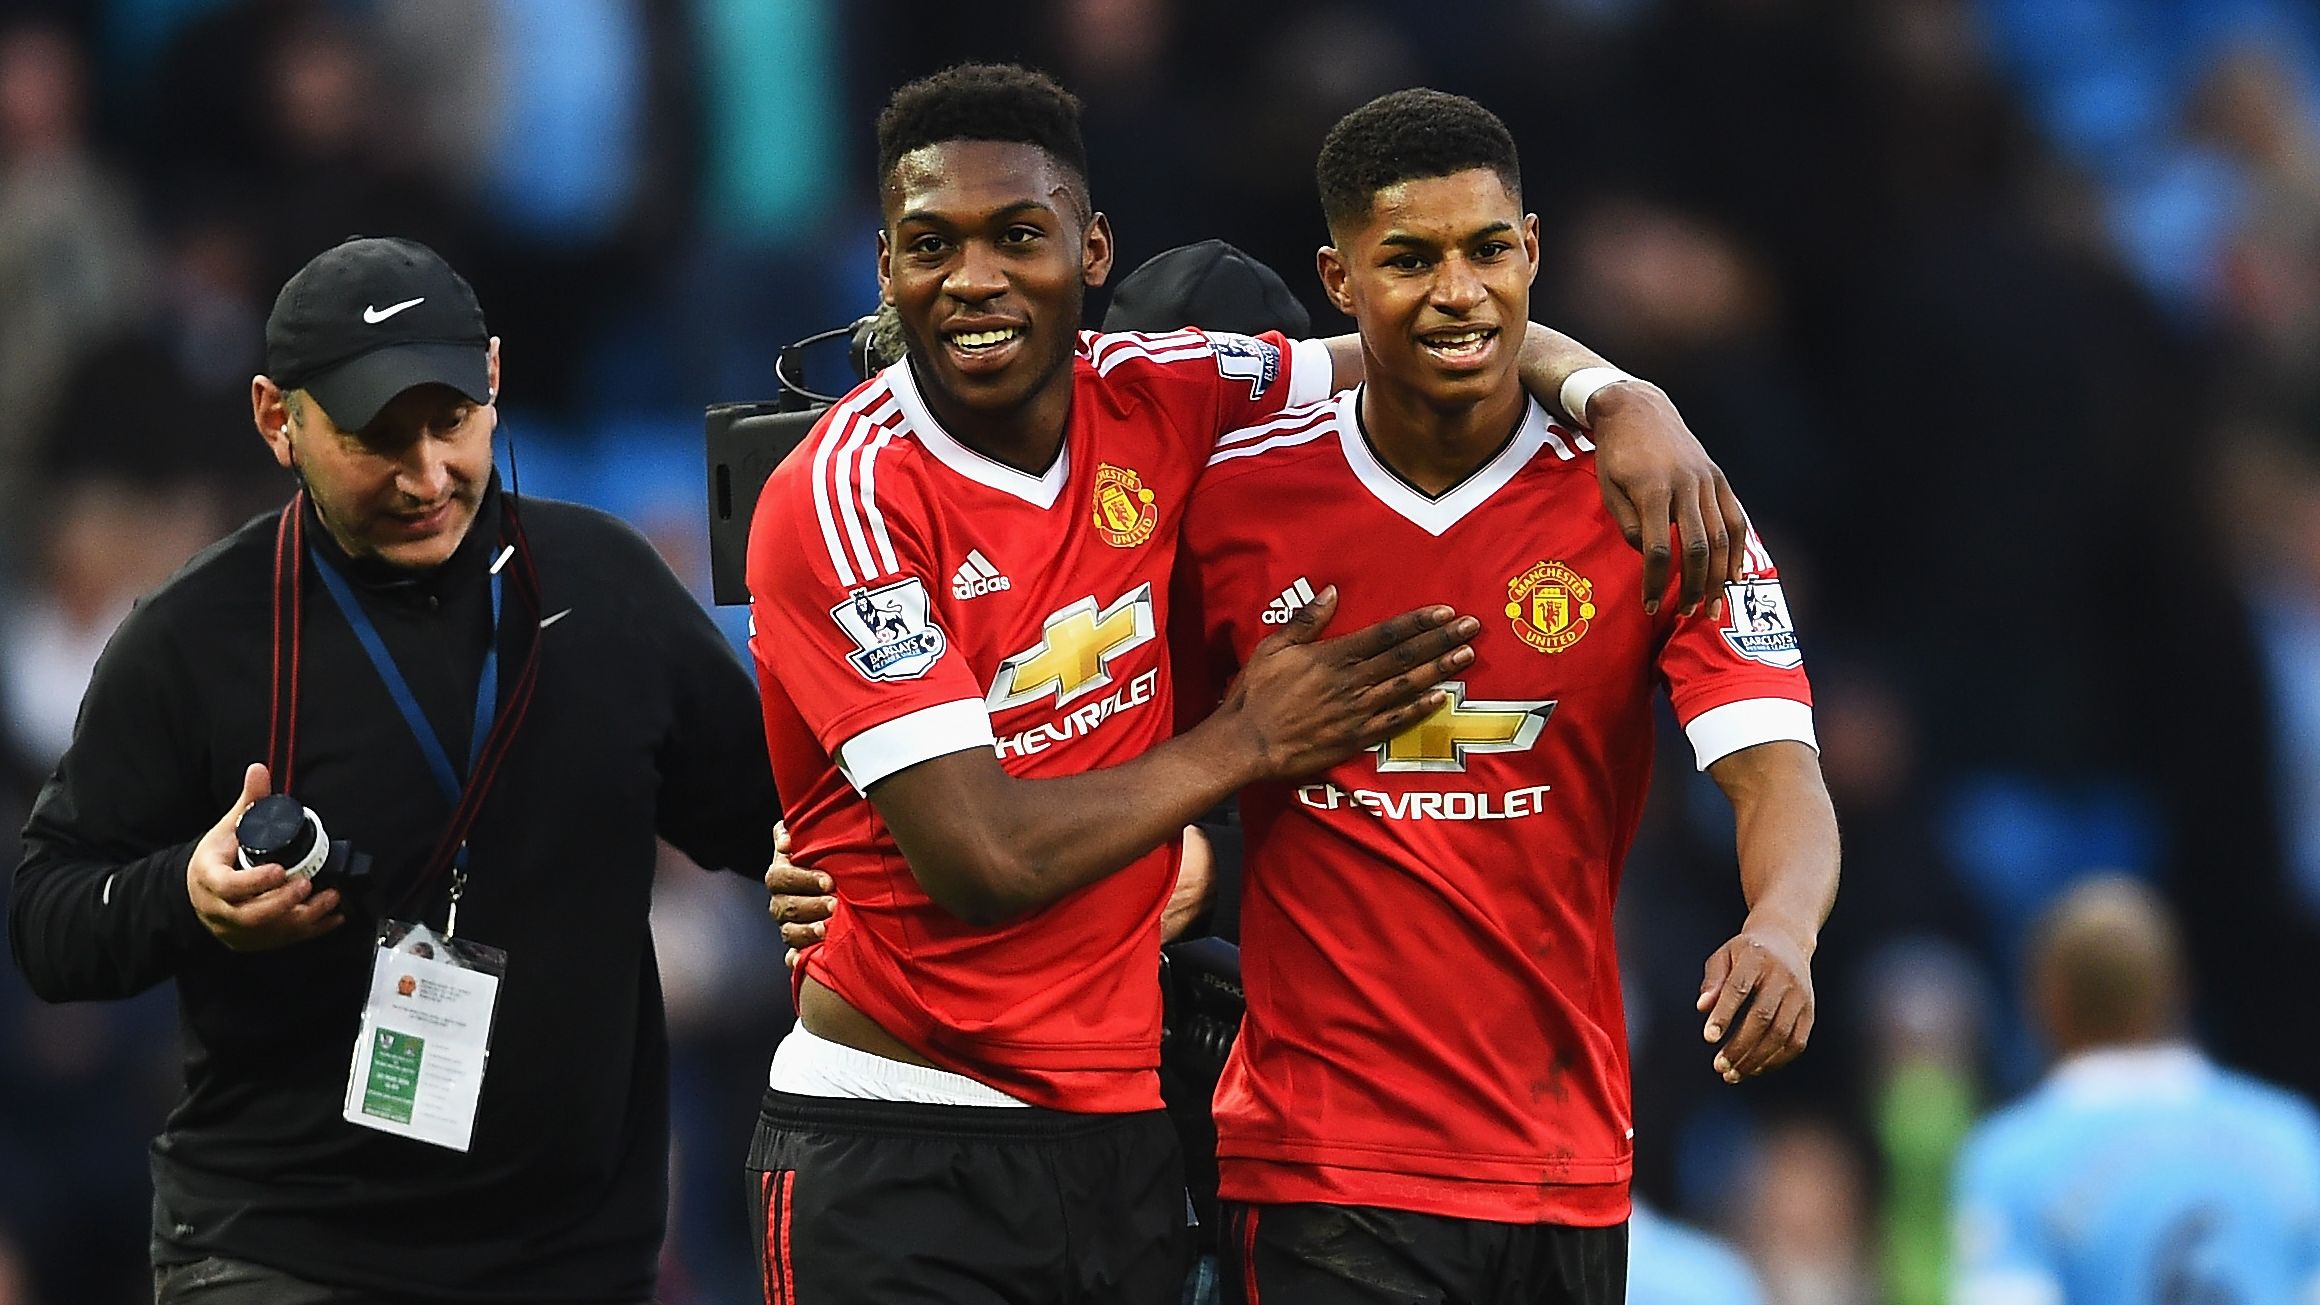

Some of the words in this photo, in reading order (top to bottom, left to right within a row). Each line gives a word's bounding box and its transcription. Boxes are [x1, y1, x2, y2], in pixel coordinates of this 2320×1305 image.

[1112, 518, 1152, 544] UNITED
[952, 575, 1011, 600] adidas
[1514, 567, 1586, 597] MANCHESTER
[869, 638, 918, 664] BARCLAYS
[1526, 631, 1576, 647] UNITED
[1741, 633, 1793, 646] BARCLAYS
[993, 666, 1157, 759] HEVROLET
